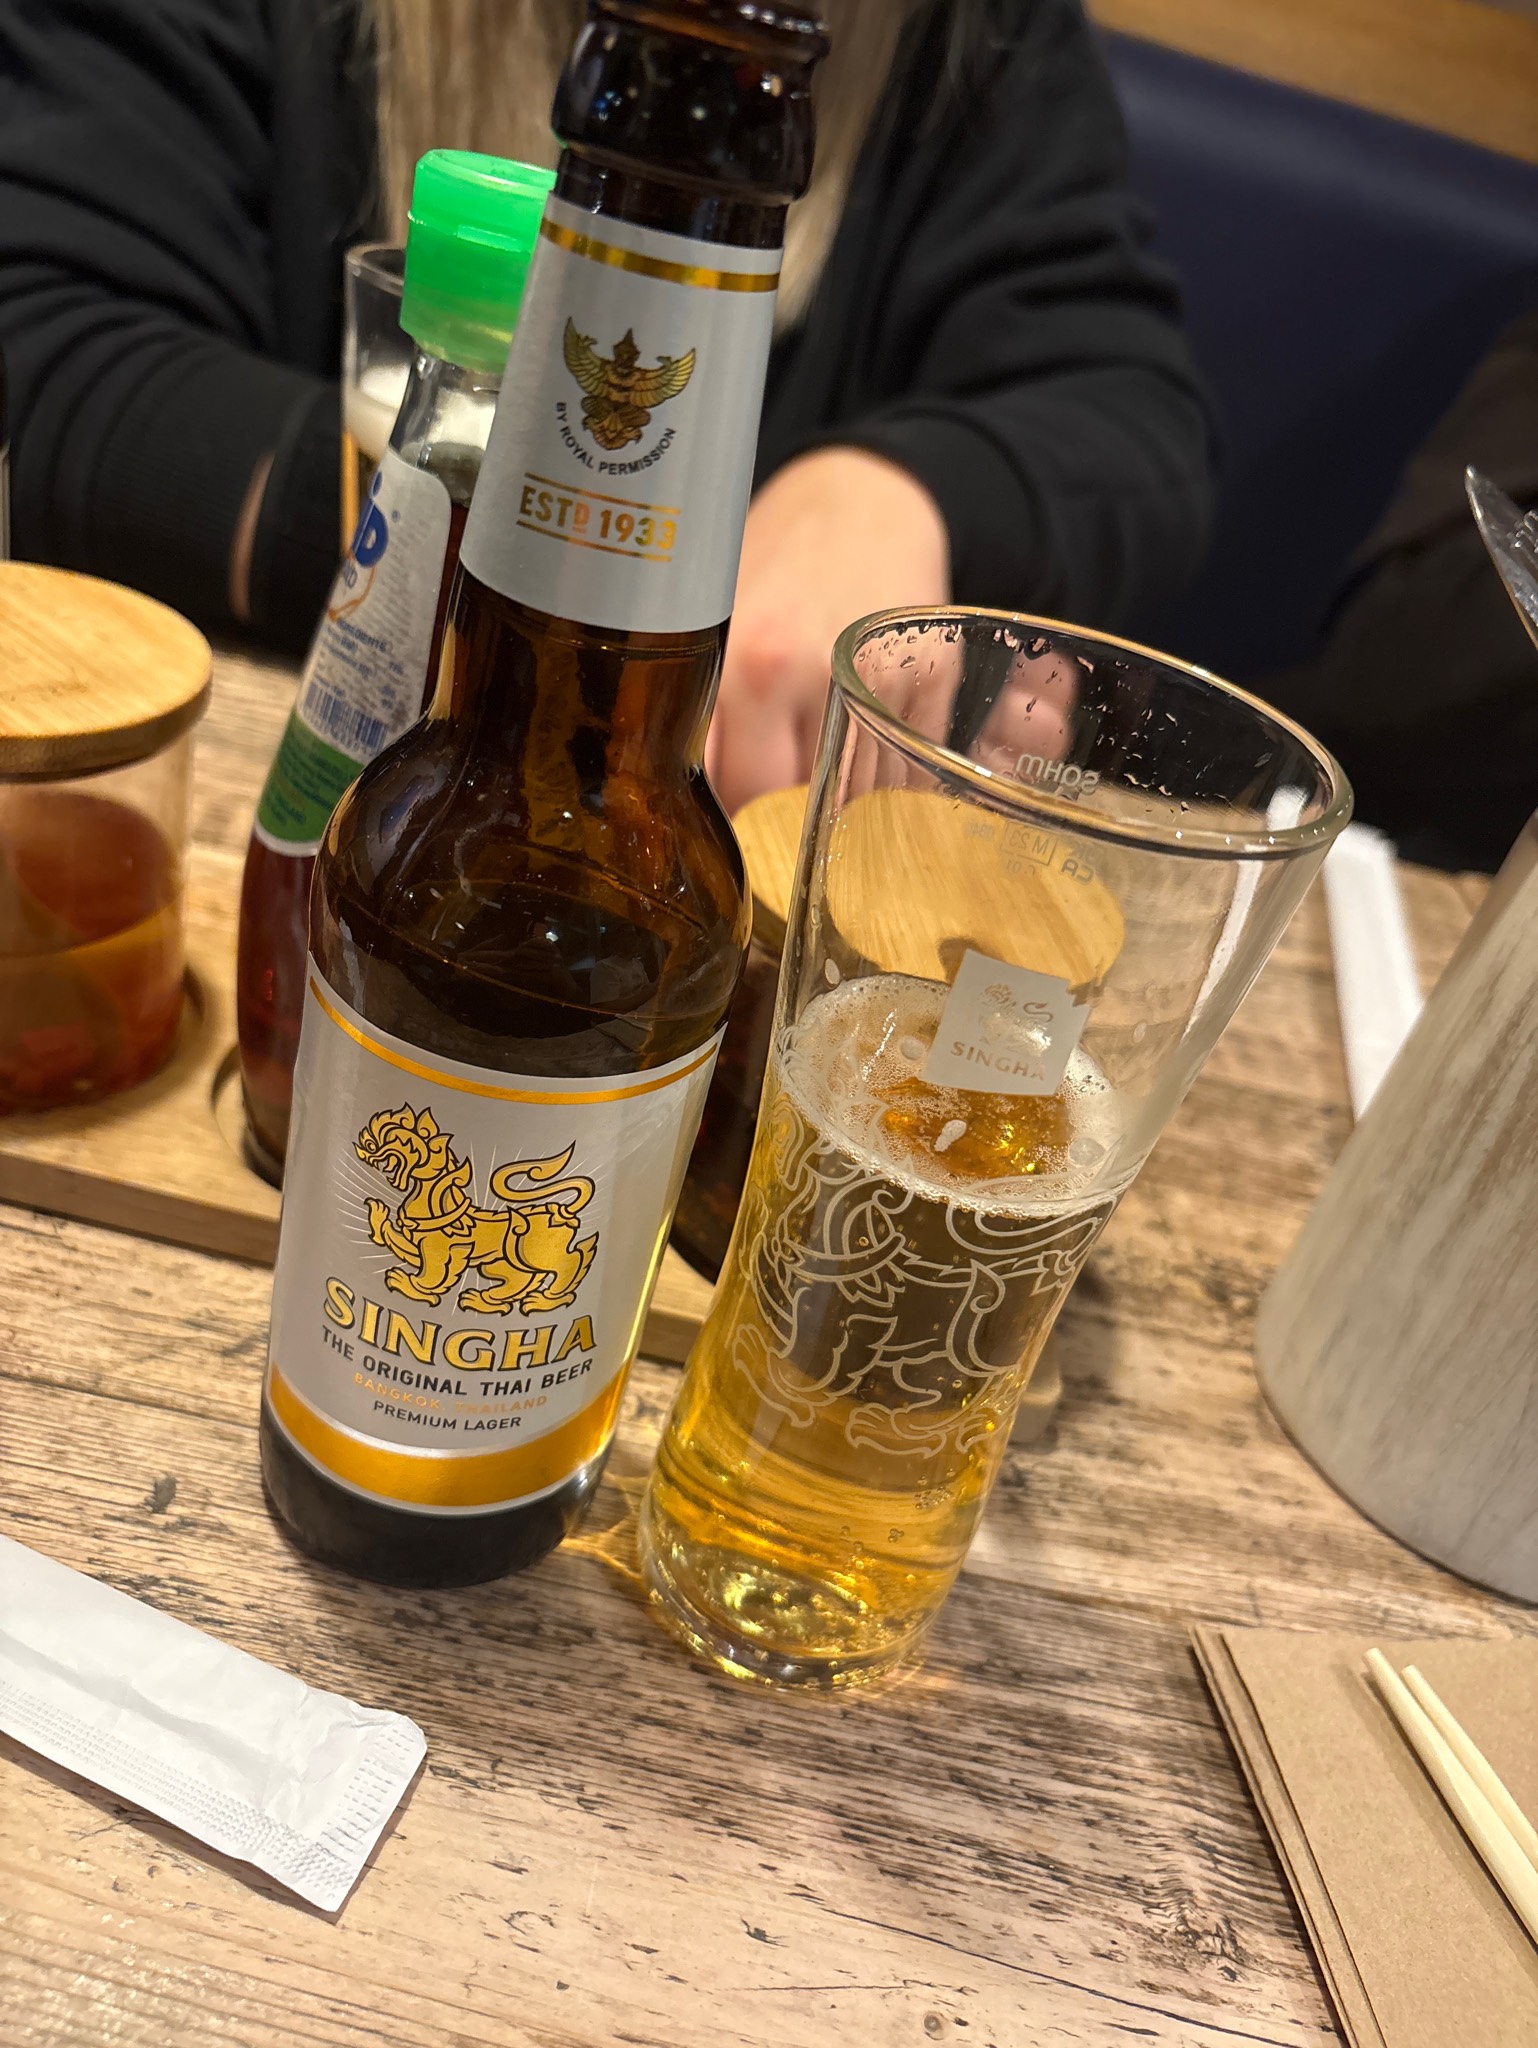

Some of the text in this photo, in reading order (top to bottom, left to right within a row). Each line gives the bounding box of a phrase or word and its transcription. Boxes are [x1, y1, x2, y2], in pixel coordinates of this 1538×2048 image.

[556, 402, 677, 476] BY ROYAL PERMISSION
[519, 486, 678, 549] ESTD 1933
[950, 1041, 1045, 1082] SINGHA
[323, 1276, 598, 1372] SINGHA
[322, 1325, 593, 1396] THE ORIGINAL THAI BEER
[374, 1400, 522, 1431] PREMIUM LAGER
[456, 1396, 547, 1415] THAILAND
